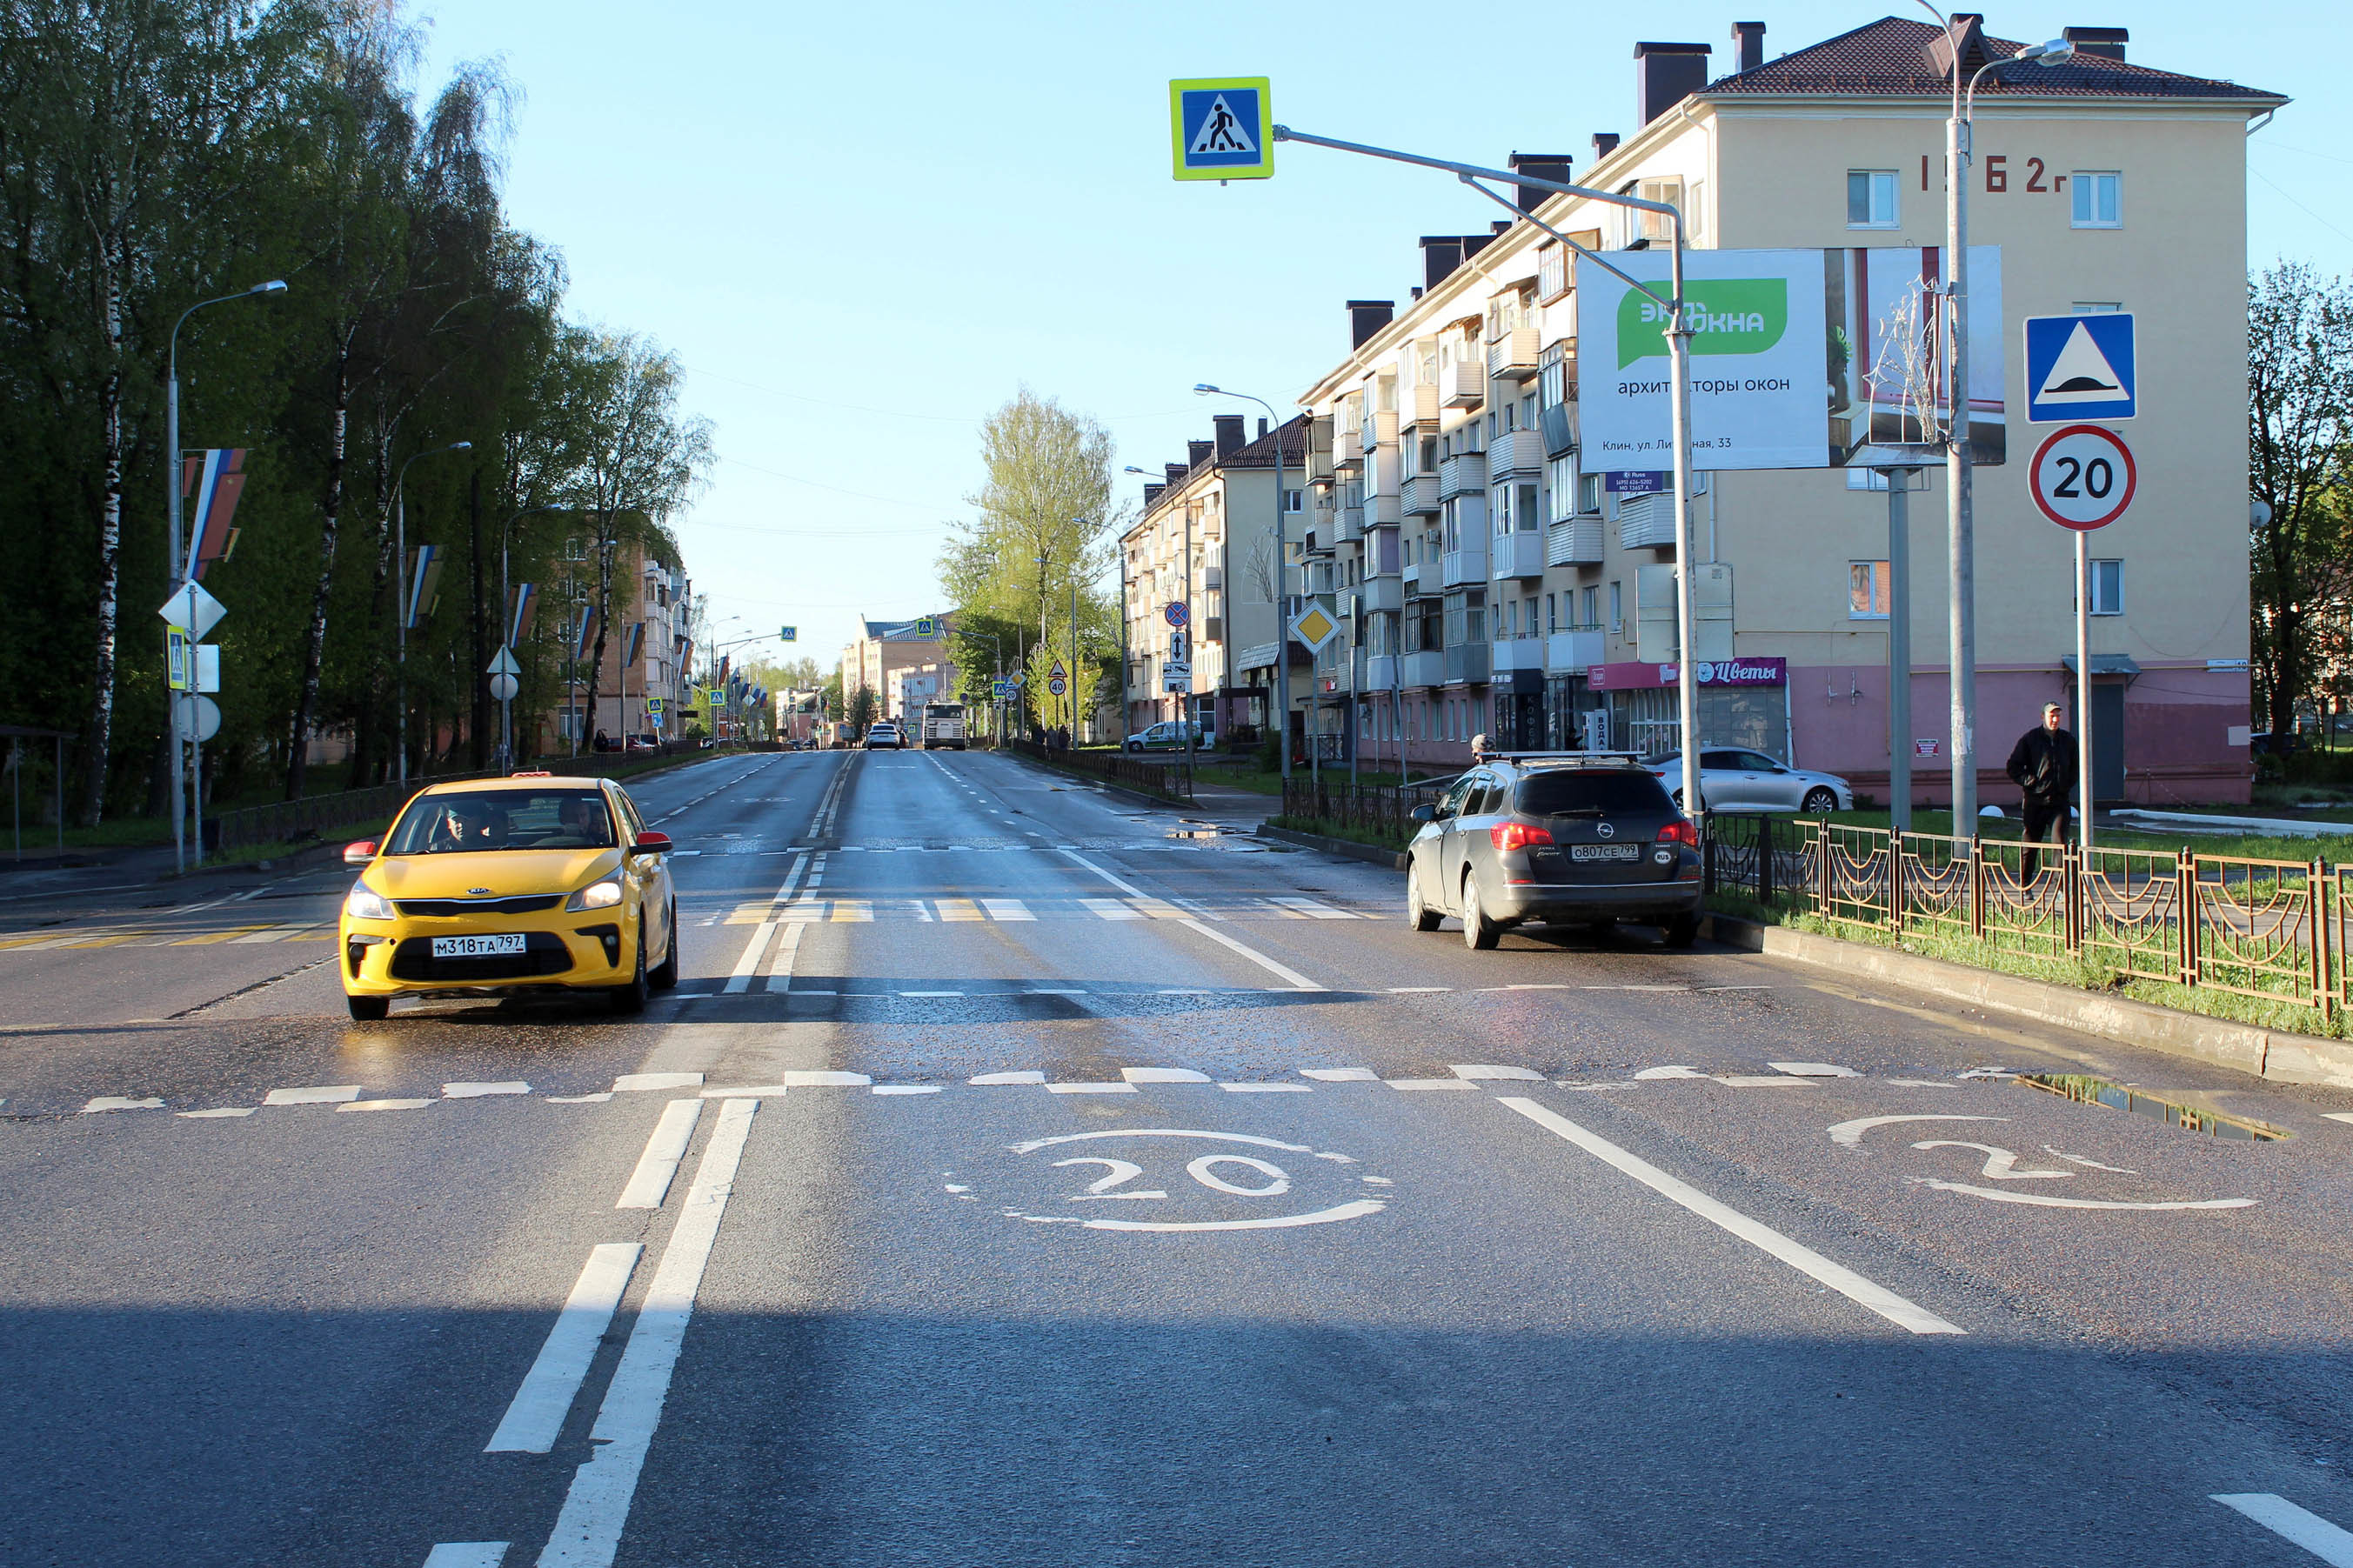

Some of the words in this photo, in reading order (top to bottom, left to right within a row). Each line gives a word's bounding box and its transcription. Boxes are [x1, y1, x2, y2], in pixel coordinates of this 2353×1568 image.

[1618, 378, 1739, 397] архитторы
[1744, 378, 1790, 391] окон
[1602, 441, 1634, 451] Клин,
[1637, 441, 1653, 452] ул.
[1656, 438, 1715, 450] Линая,
[1718, 437, 1732, 448] 33
[2053, 457, 2113, 498] 20
[1715, 662, 1776, 683] Цветы
[498, 936, 520, 948] 797
[1051, 1154, 1291, 1200] 20
